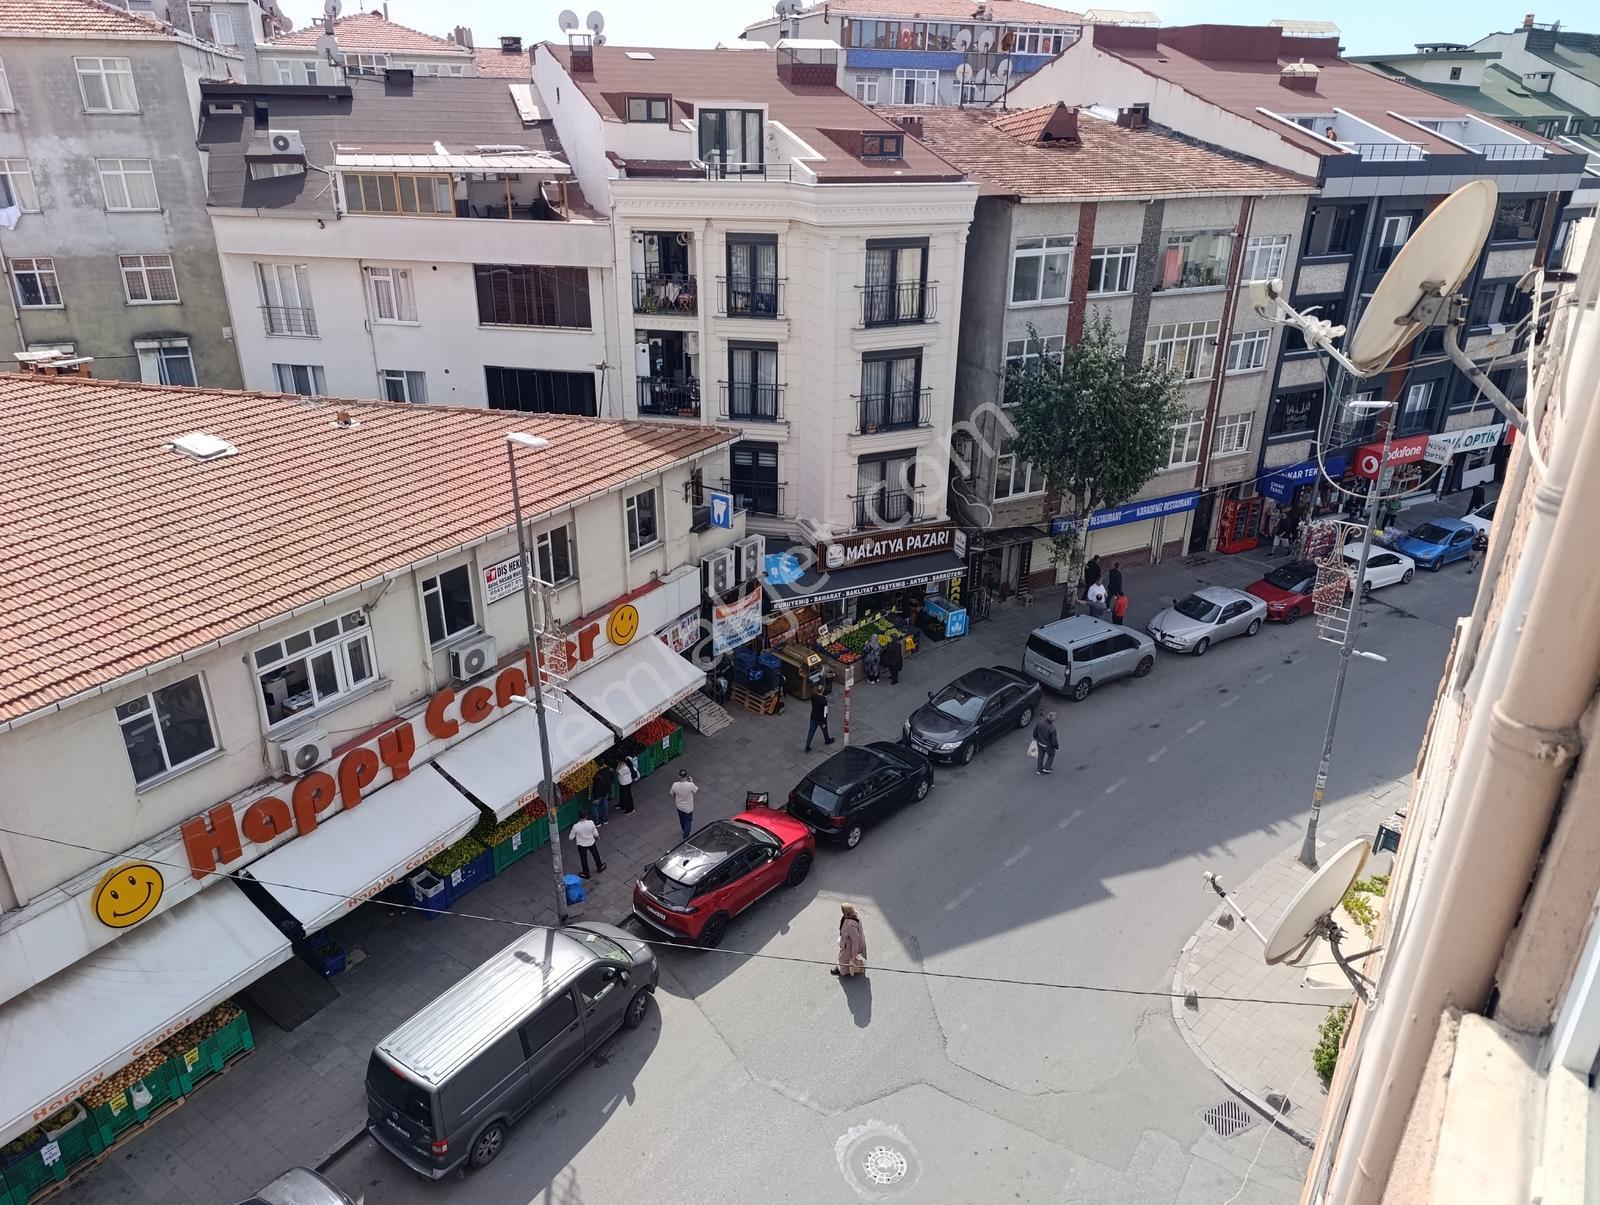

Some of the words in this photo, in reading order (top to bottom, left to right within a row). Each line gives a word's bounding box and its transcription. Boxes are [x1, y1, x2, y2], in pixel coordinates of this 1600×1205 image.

[1427, 442, 1447, 453] NEVA
[1464, 429, 1499, 447] OPTİK
[1384, 445, 1422, 462] odafone
[1424, 451, 1446, 462] OPTİK
[1163, 497, 1193, 511] RESTAURANT
[847, 538, 905, 561] MALATYA
[906, 530, 950, 552] PAZARI
[497, 564, 508, 577] DİŞ
[773, 599, 810, 610] KURUYEMİŞ
[814, 592, 842, 602] BAHARAT
[845, 587, 875, 598] BAKLİYAT
[634, 707, 663, 728] Happy
[669, 688, 694, 706] Center
[180, 721, 416, 881] Happy
[347, 875, 395, 909] Happy
[405, 841, 447, 871] Center
[32, 1072, 105, 1122] Happy
[131, 1015, 193, 1057] Center
